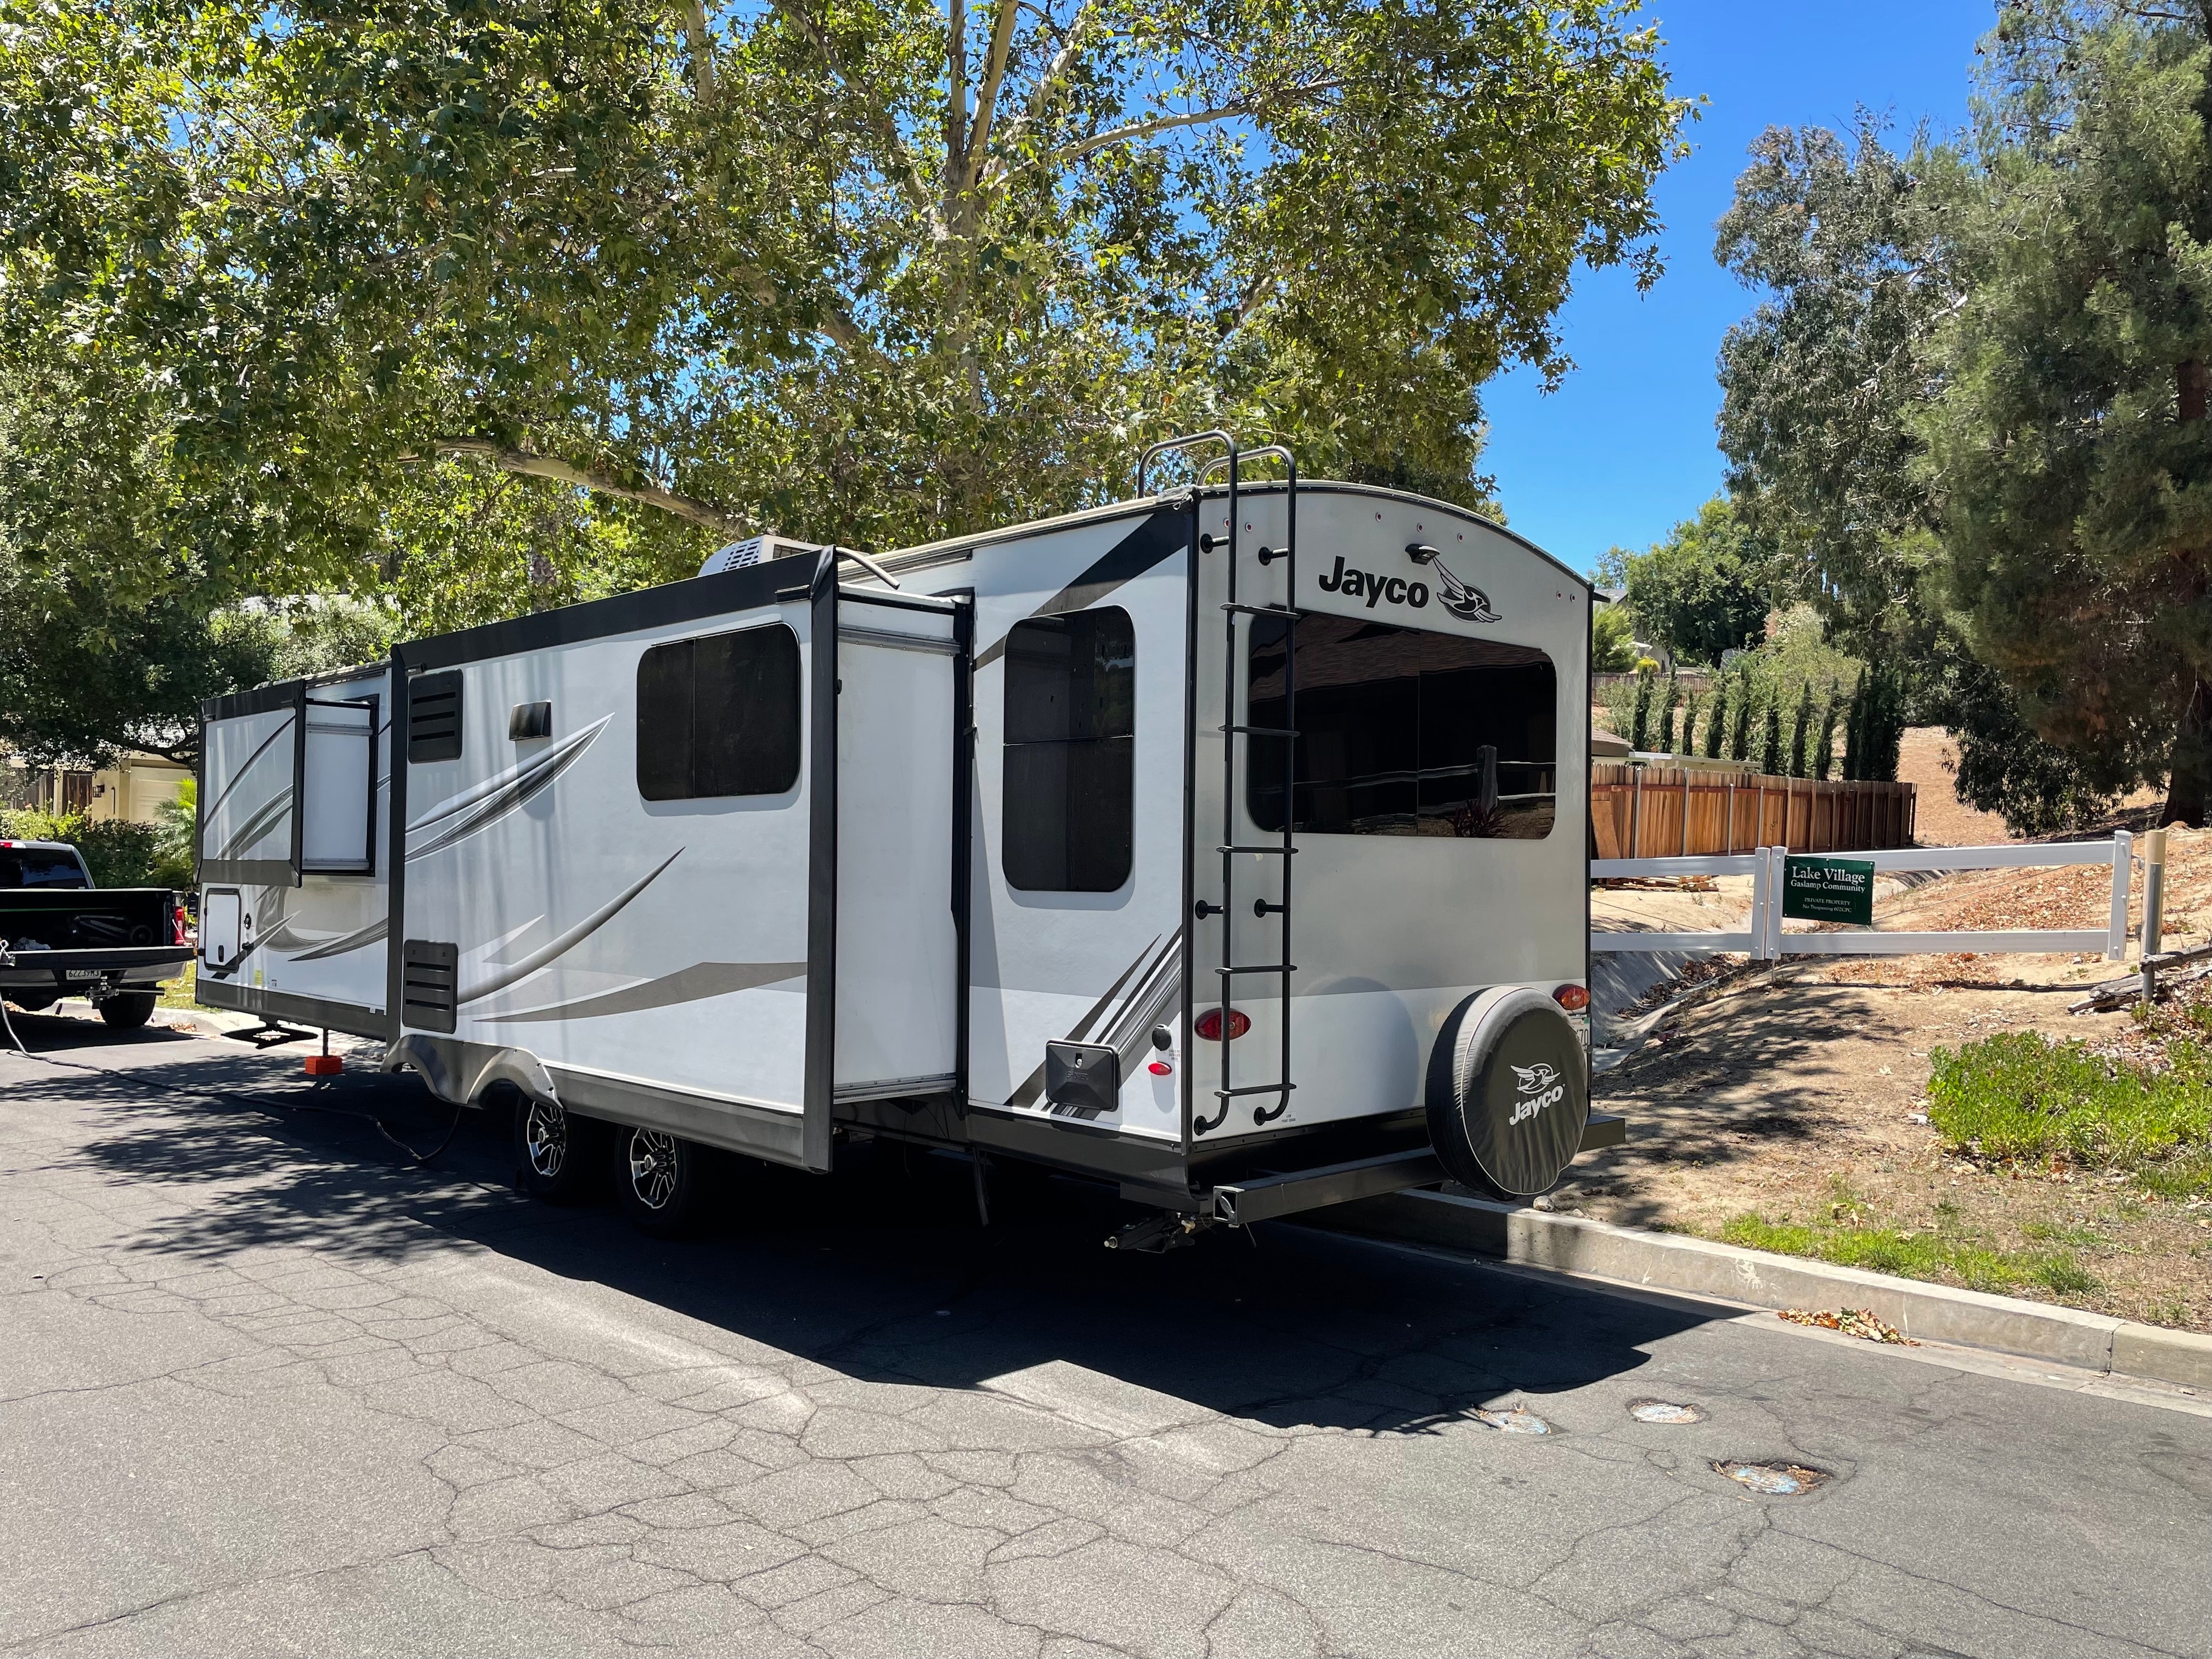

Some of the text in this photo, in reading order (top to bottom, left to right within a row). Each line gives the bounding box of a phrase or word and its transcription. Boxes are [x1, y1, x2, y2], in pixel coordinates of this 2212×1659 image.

[1318, 555, 1429, 608] Jayco
[1791, 879, 1865, 894] Gaslamp Community
[1792, 866, 1865, 885] Lake Village
[1509, 1085, 1564, 1126] Jayco
